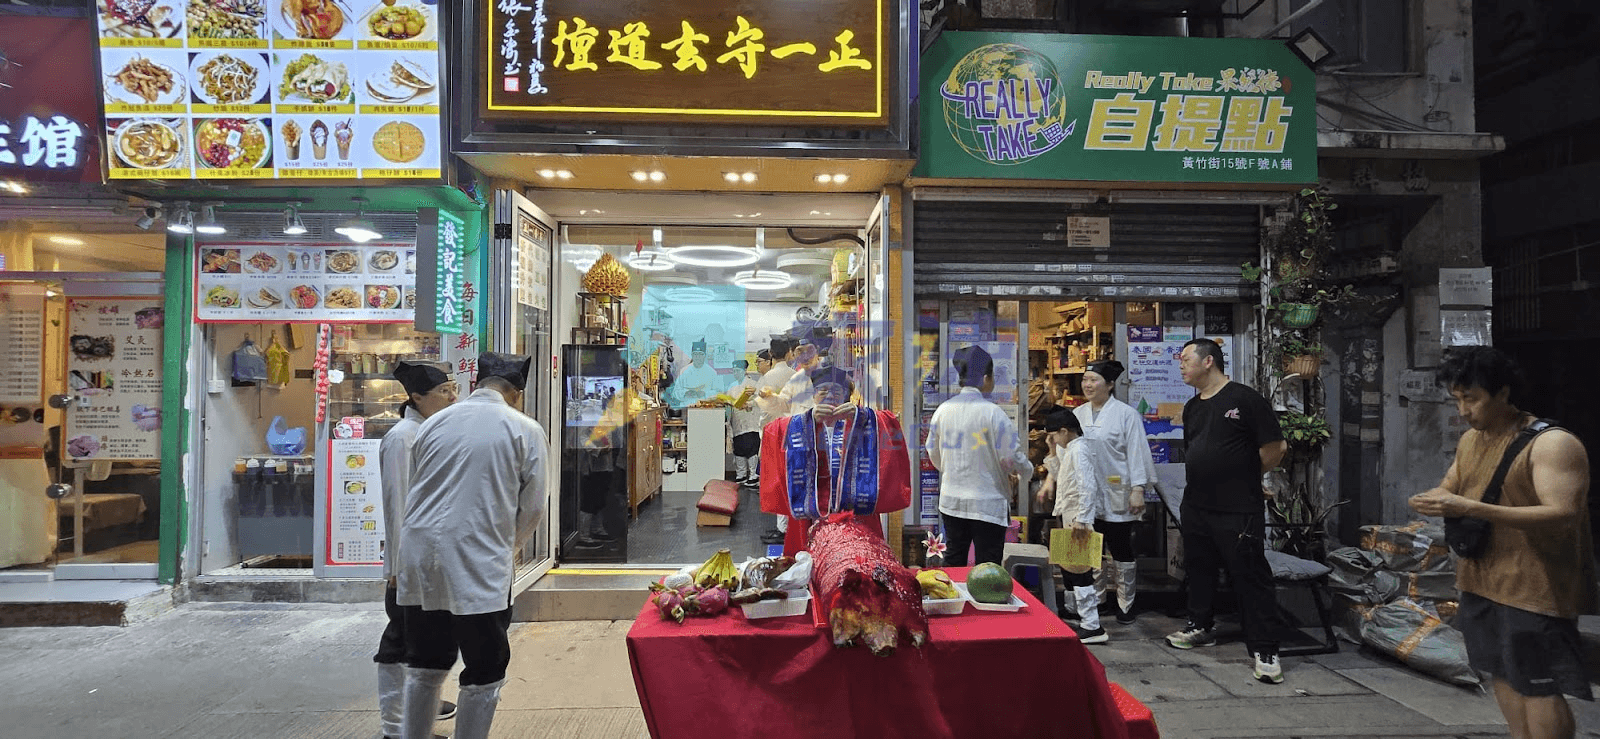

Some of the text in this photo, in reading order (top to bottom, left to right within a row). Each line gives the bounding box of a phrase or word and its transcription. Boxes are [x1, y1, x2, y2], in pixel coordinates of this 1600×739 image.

[963, 78, 1052, 120] REALLY
[1084, 70, 1156, 94] Really
[1159, 71, 1214, 92] Take
[978, 117, 1039, 161] TAKE
[1084, 92, 1294, 153] 自提點
[441, 220, 460, 326] 發記美食
